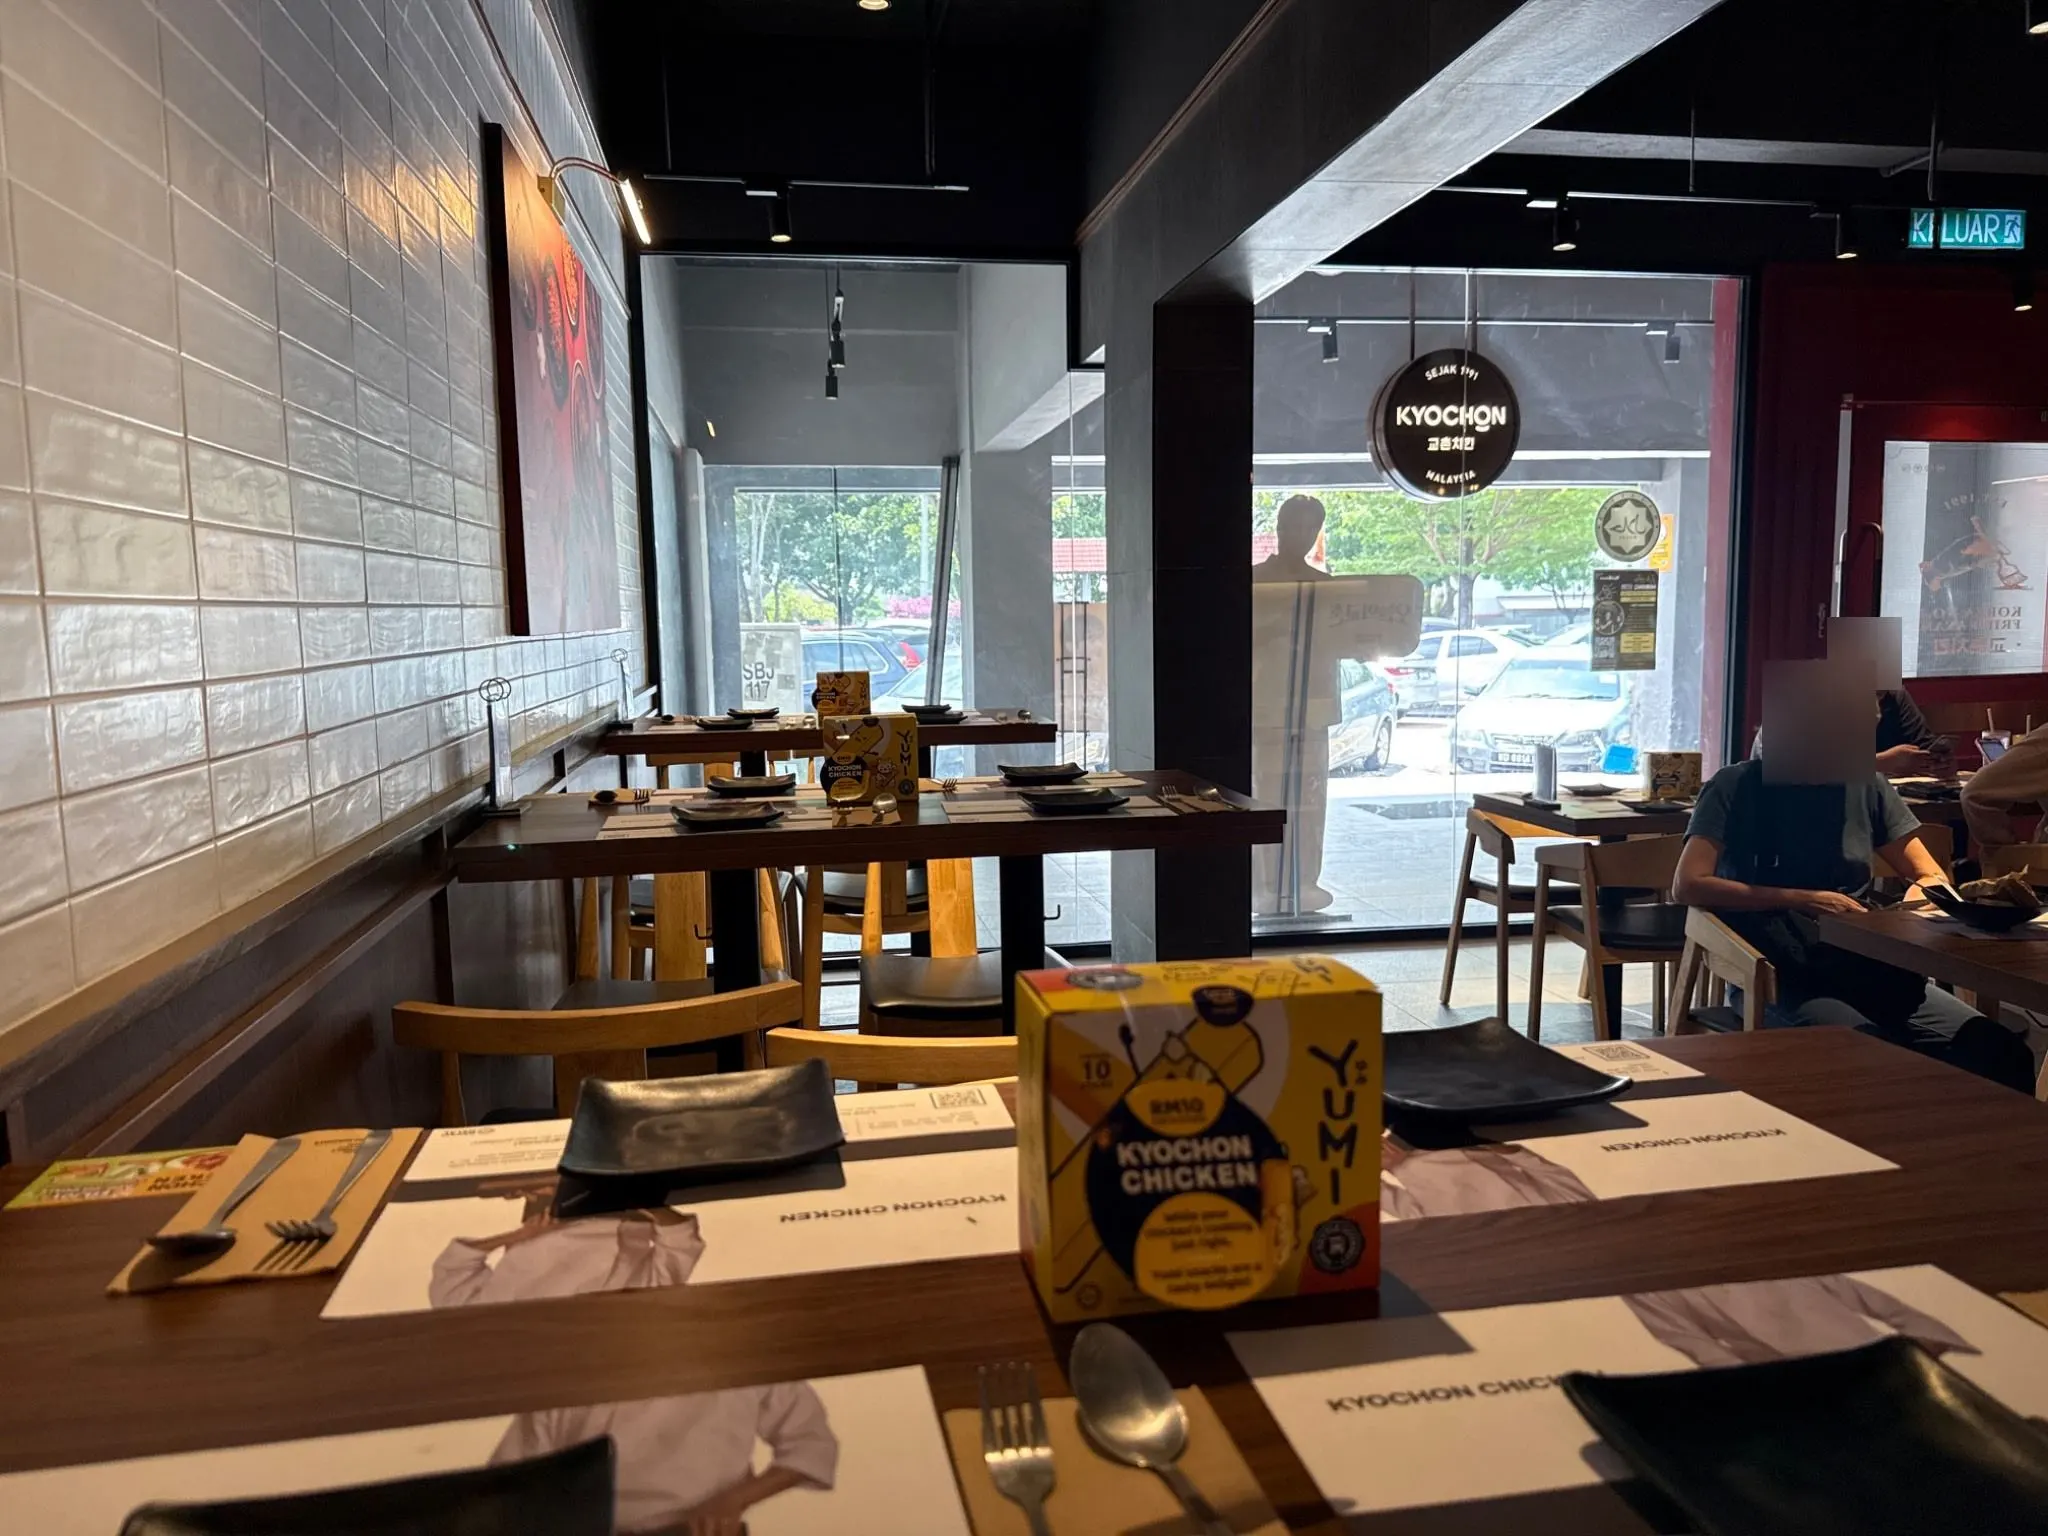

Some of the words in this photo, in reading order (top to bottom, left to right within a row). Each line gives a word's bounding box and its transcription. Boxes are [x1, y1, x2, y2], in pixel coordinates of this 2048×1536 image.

[1425, 364, 1457, 381] SEJAK
[1396, 405, 1507, 432] KYOCHON
[1425, 469, 1477, 484] MALAYSIA
[743, 661, 775, 680] SBJ
[896, 729, 912, 776] YUMI
[828, 764, 862, 772] KYOCHON
[1081, 1059, 1111, 1081] 10
[1307, 1039, 1358, 1206] YUMI
[1601, 1135, 1692, 1152] CHICKEN
[1692, 1127, 1788, 1146] KYOCHON
[1116, 1133, 1252, 1168] KYOCHON
[1120, 1161, 1258, 1195] CHICKEN
[779, 1204, 888, 1223] CHICKEN
[893, 1193, 1006, 1214] KYOCHON
[1327, 1384, 1475, 1414] KYOCHON
